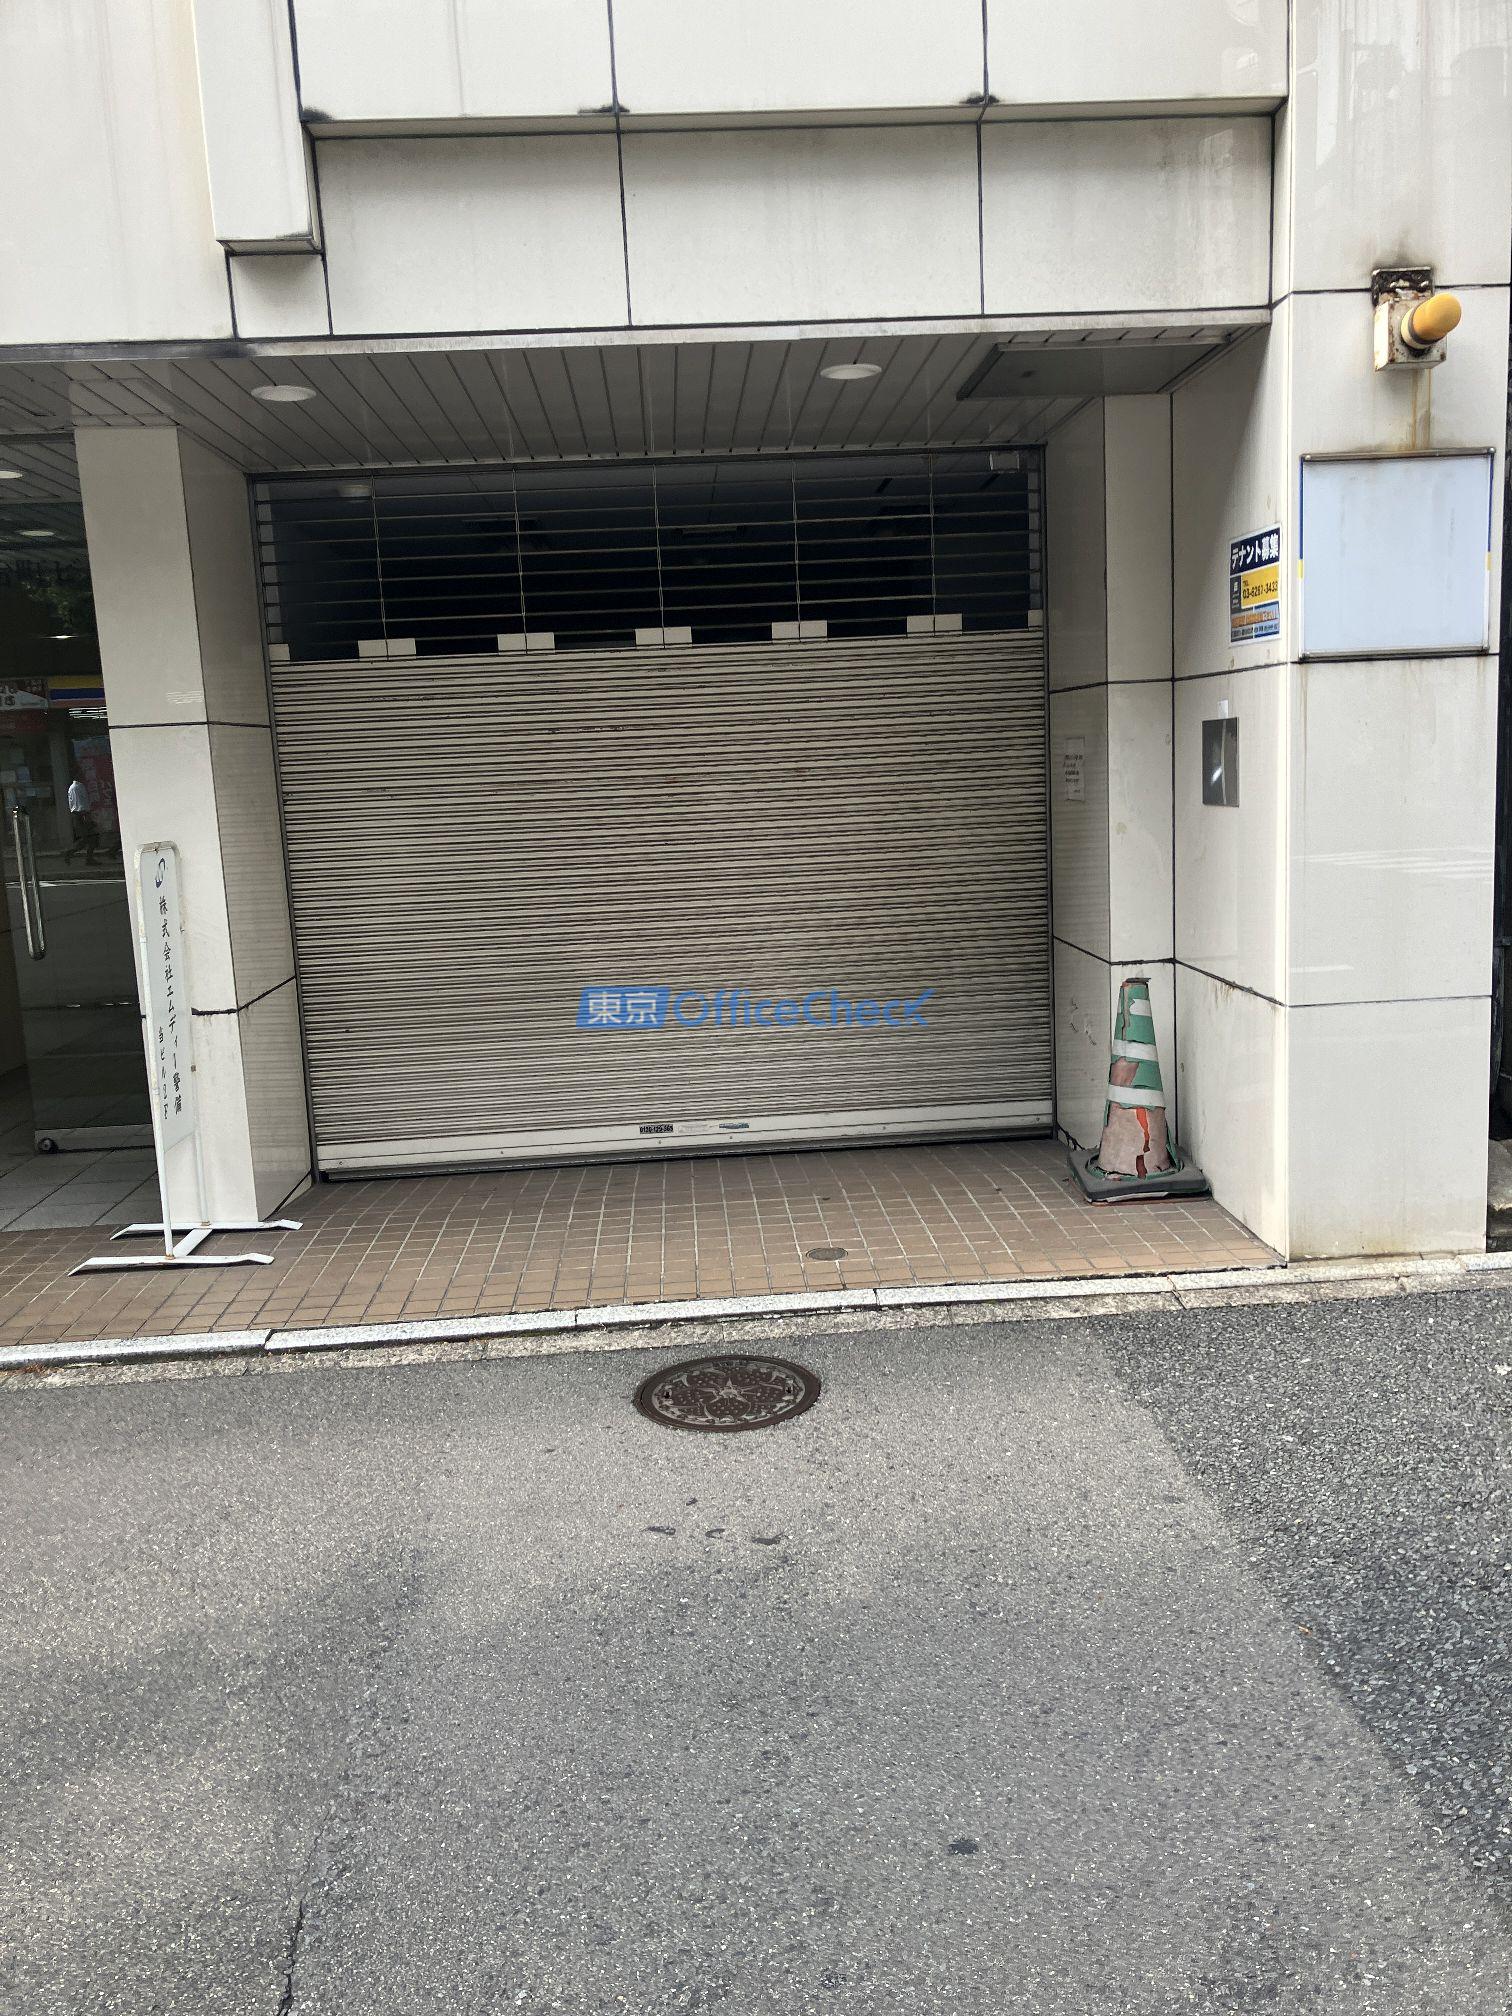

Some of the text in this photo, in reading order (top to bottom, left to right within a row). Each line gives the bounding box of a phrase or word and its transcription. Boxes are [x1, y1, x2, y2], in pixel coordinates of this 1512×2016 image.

[1231, 533, 1279, 570] テナント募集
[158, 896, 182, 1115] 株式会社エムディー警備
